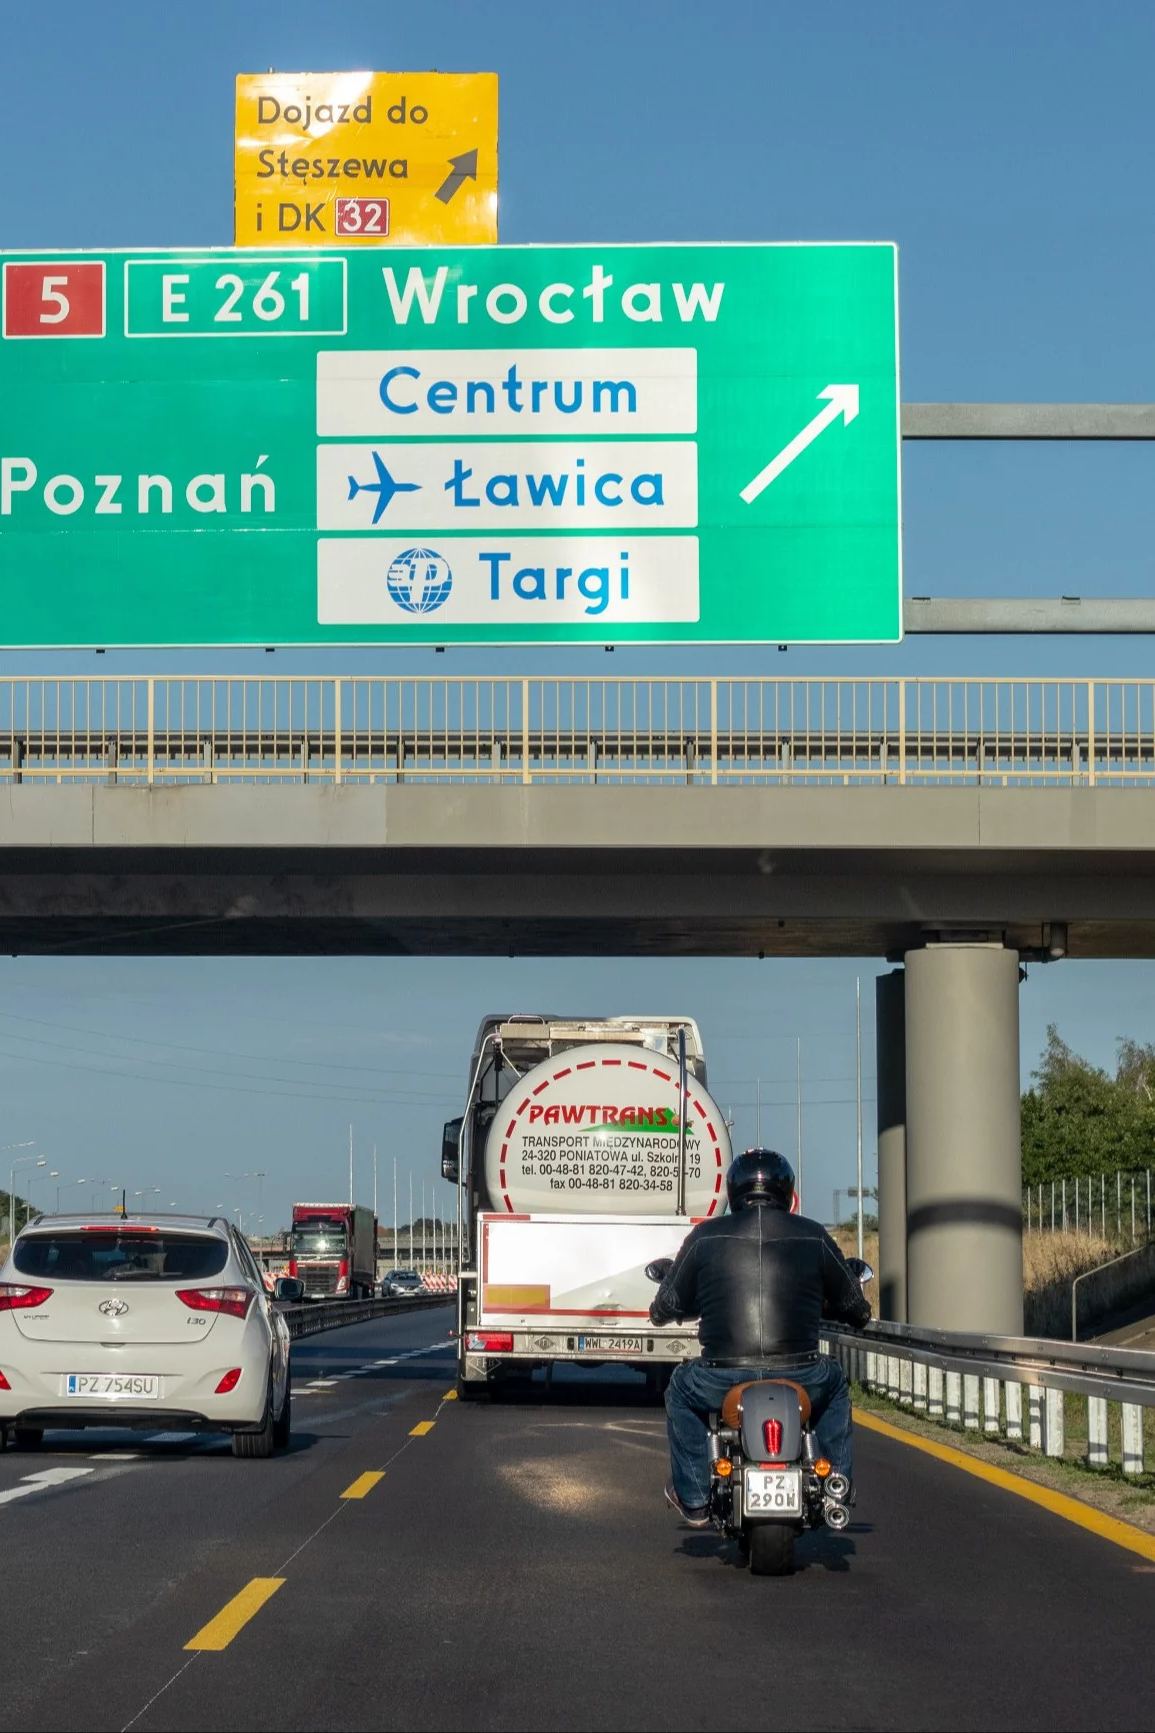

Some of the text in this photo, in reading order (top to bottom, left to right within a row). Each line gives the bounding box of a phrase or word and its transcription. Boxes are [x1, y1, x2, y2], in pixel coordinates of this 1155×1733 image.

[257, 95, 429, 131] Dojazd do
[256, 149, 408, 186] Stęszewa
[256, 203, 383, 232] i DK 32
[38, 275, 71, 325] 5
[160, 272, 313, 323] E 261
[381, 264, 727, 325] Wrocław
[379, 363, 639, 416] Centrum
[0, 454, 277, 516] Poznań
[444, 458, 666, 508] Ławica
[478, 551, 632, 615] Targi
[528, 1104, 669, 1127] PAWTRANS
[521, 1150, 557, 1162] 24-320
[559, 1150, 629, 1163] PONIATOWA
[631, 1152, 644, 1163] ul.
[689, 1153, 701, 1165] 19
[522, 1136, 701, 1151] TRANSPORT MIĘDZYNARODWY
[522, 1164, 701, 1178] tel. 00-48-81 820-47-42, 820-5-70
[550, 1177, 673, 1191] fax 00-48-81 820-34-58
[585, 1337, 641, 1350] WWL 2419A
[78, 1377, 154, 1394] PZ 754SU
[763, 1475, 784, 1489] PZ
